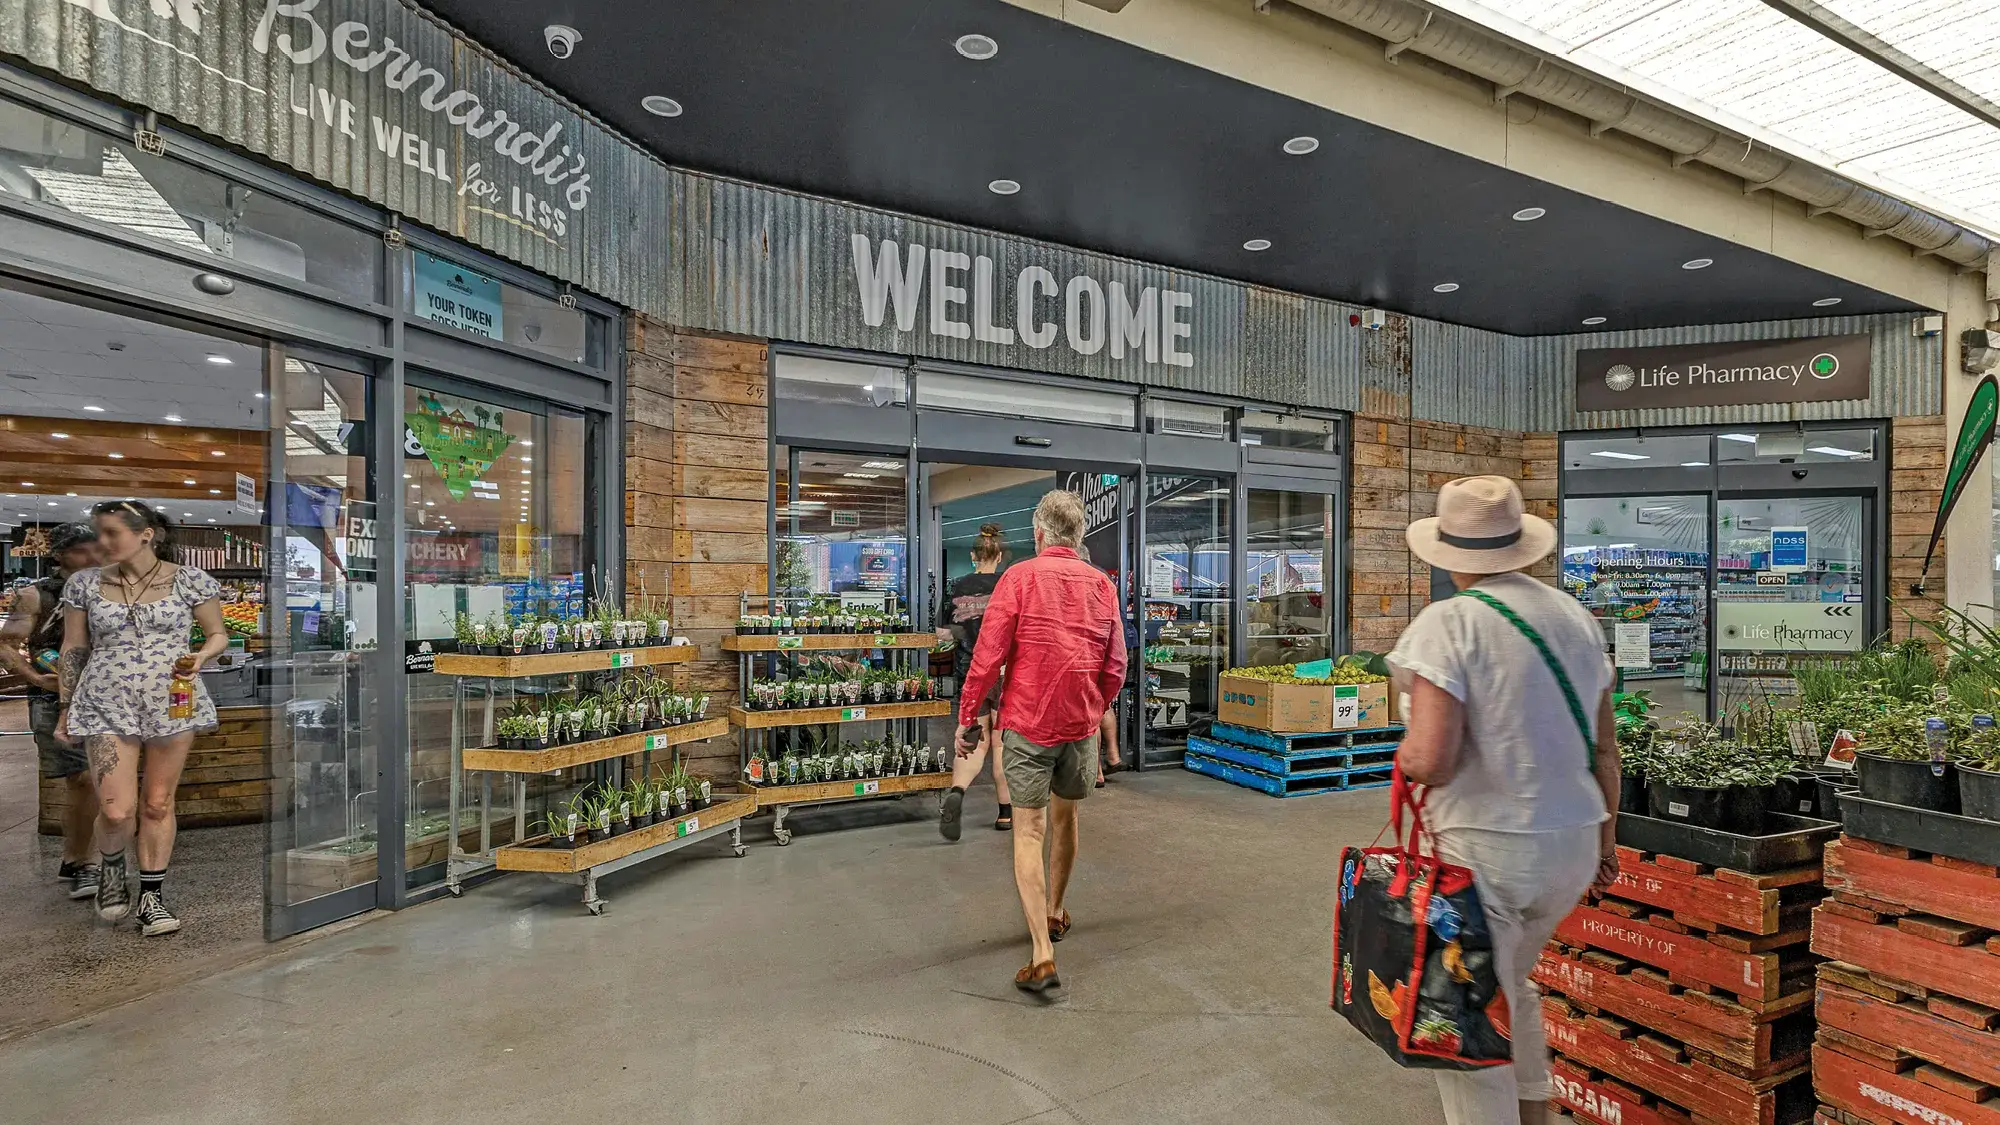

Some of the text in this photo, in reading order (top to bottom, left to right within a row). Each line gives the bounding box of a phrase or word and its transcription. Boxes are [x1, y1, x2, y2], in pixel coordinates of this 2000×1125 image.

[253, 0, 592, 211] Bernardi's
[290, 73, 567, 237] LIVE WELL for LESS
[427, 292, 492, 328] YOUR TOKEN
[851, 233, 1194, 368] WELCOME
[1640, 362, 1805, 387] Life Pharmacy
[1590, 555, 1684, 569] Opening Hours
[1760, 576, 1784, 584] OPEN
[1743, 624, 1854, 644] Life Pharmacy
[1582, 918, 1677, 955] PROPERTY OF
